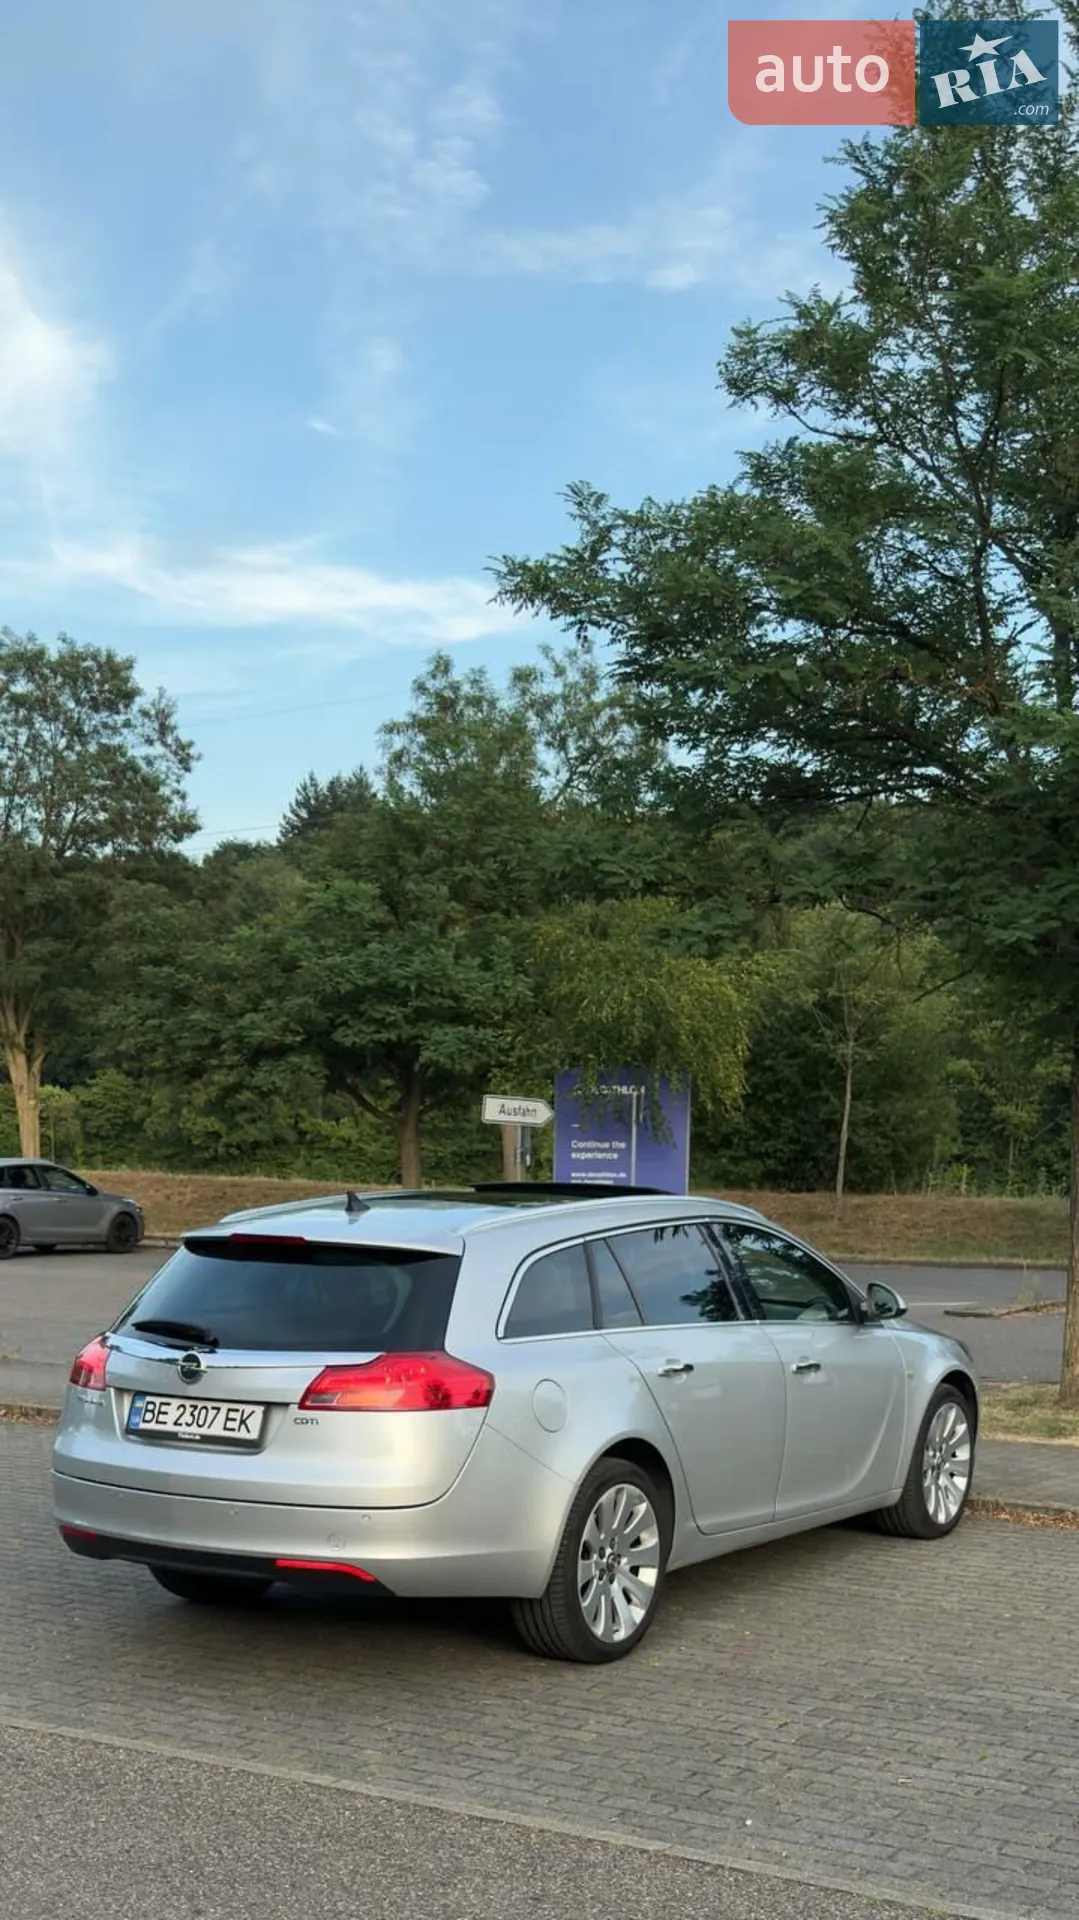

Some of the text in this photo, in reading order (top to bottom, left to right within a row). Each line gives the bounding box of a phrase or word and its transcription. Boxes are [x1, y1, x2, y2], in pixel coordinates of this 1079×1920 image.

[498, 1103, 538, 1117] Ausfahrt
[571, 1140, 627, 1149] Continue the
[571, 1152, 619, 1161] experience
[142, 1400, 256, 1434] BE 2307 EK
